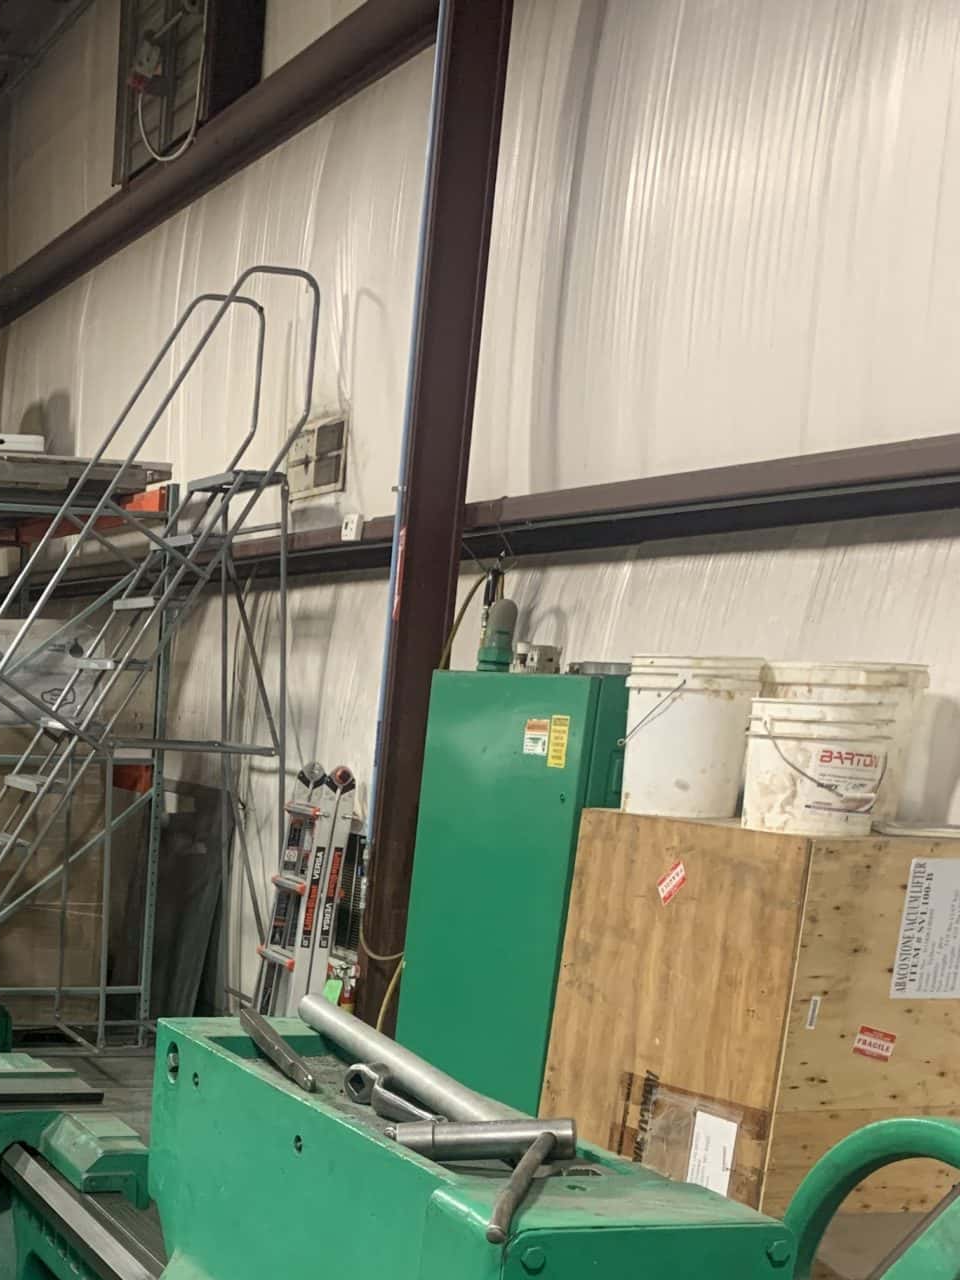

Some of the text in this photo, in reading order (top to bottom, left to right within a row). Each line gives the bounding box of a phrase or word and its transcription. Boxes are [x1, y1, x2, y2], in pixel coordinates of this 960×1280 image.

[820, 748, 880, 769] BARTON
[312, 851, 323, 880] VERSA
[322, 903, 333, 930] VERSA
[894, 862, 926, 991] ABACO STONE VACUUM LIFTER
[908, 947, 921, 982] ITEM
[857, 1038, 890, 1053] FRAGILE
